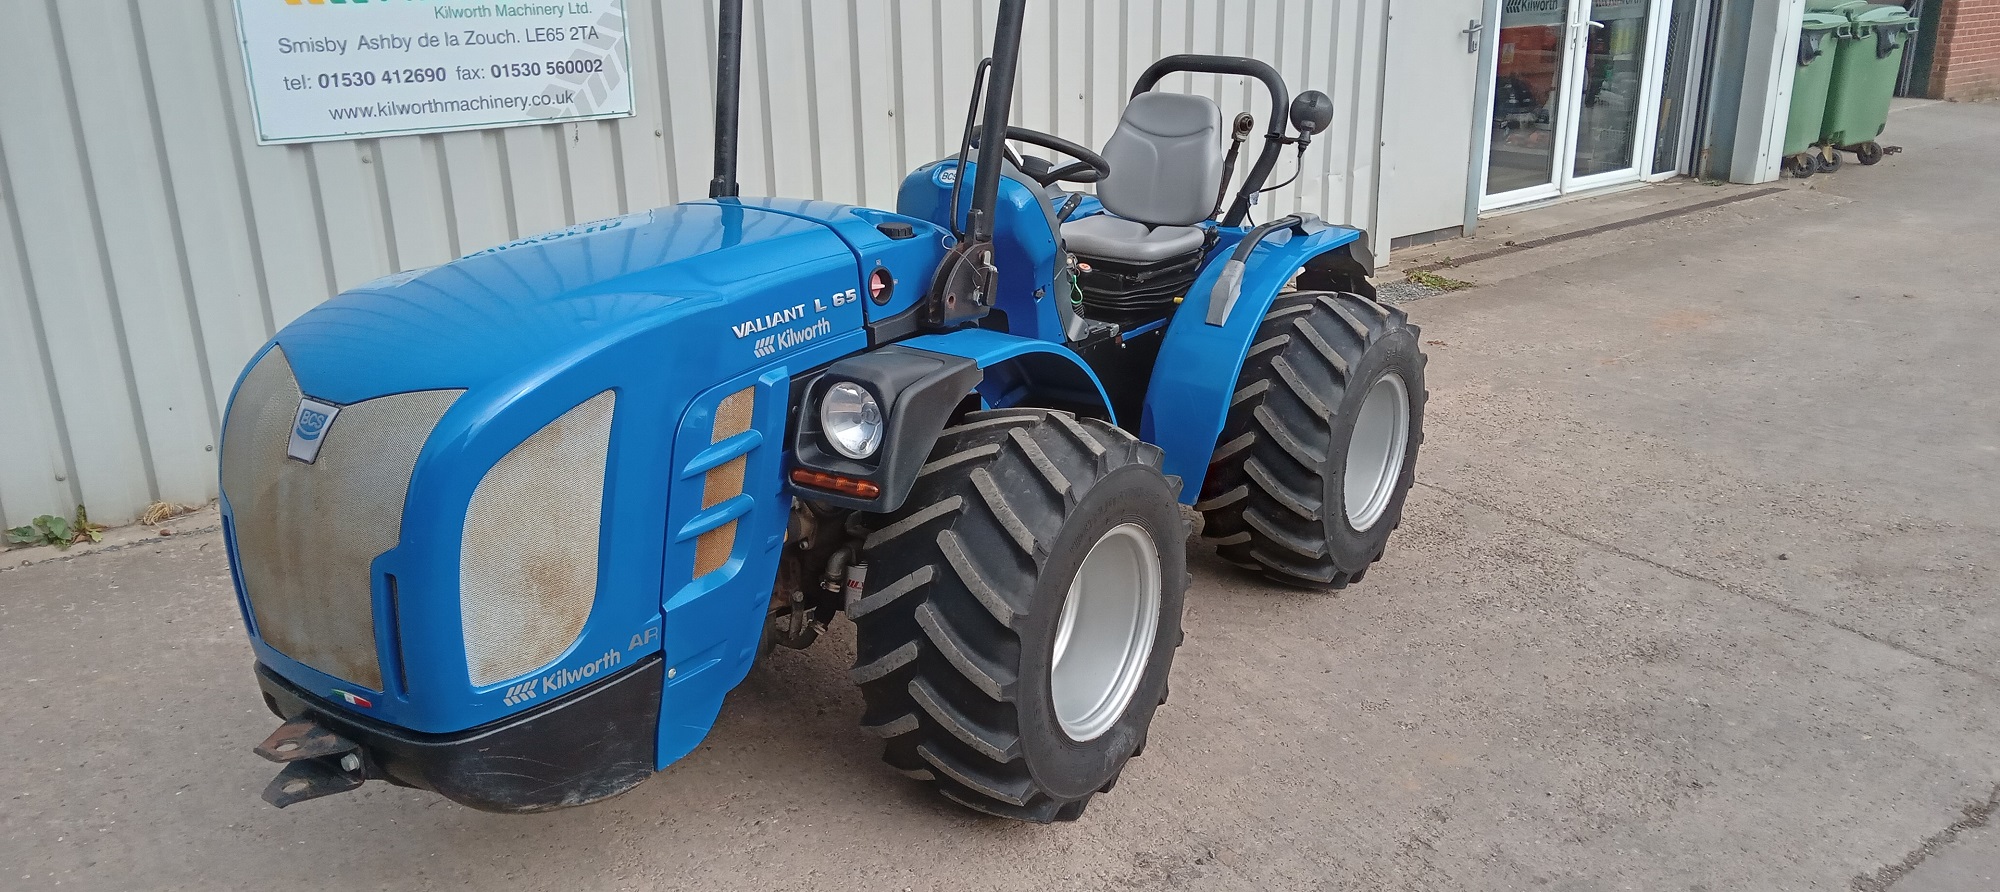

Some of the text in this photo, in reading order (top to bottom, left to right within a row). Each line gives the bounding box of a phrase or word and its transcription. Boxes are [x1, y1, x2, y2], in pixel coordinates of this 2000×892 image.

[434, 2, 592, 19] Kilworth Machinery Ltd.
[1521, 0, 1558, 12] Kilworth
[278, 25, 600, 56] Smisby Ashby de la Zouch. LE65 2TA
[283, 58, 603, 91] tel: 01530 412690 fax: 01530 560002
[328, 89, 574, 121] www.kilworthmachinery.co.uk
[731, 288, 857, 339] VALIANT L 65
[777, 317, 831, 351] Kilworth
[300, 410, 325, 429] BCS
[627, 626, 659, 651] AR
[542, 648, 621, 695] Kilworth
